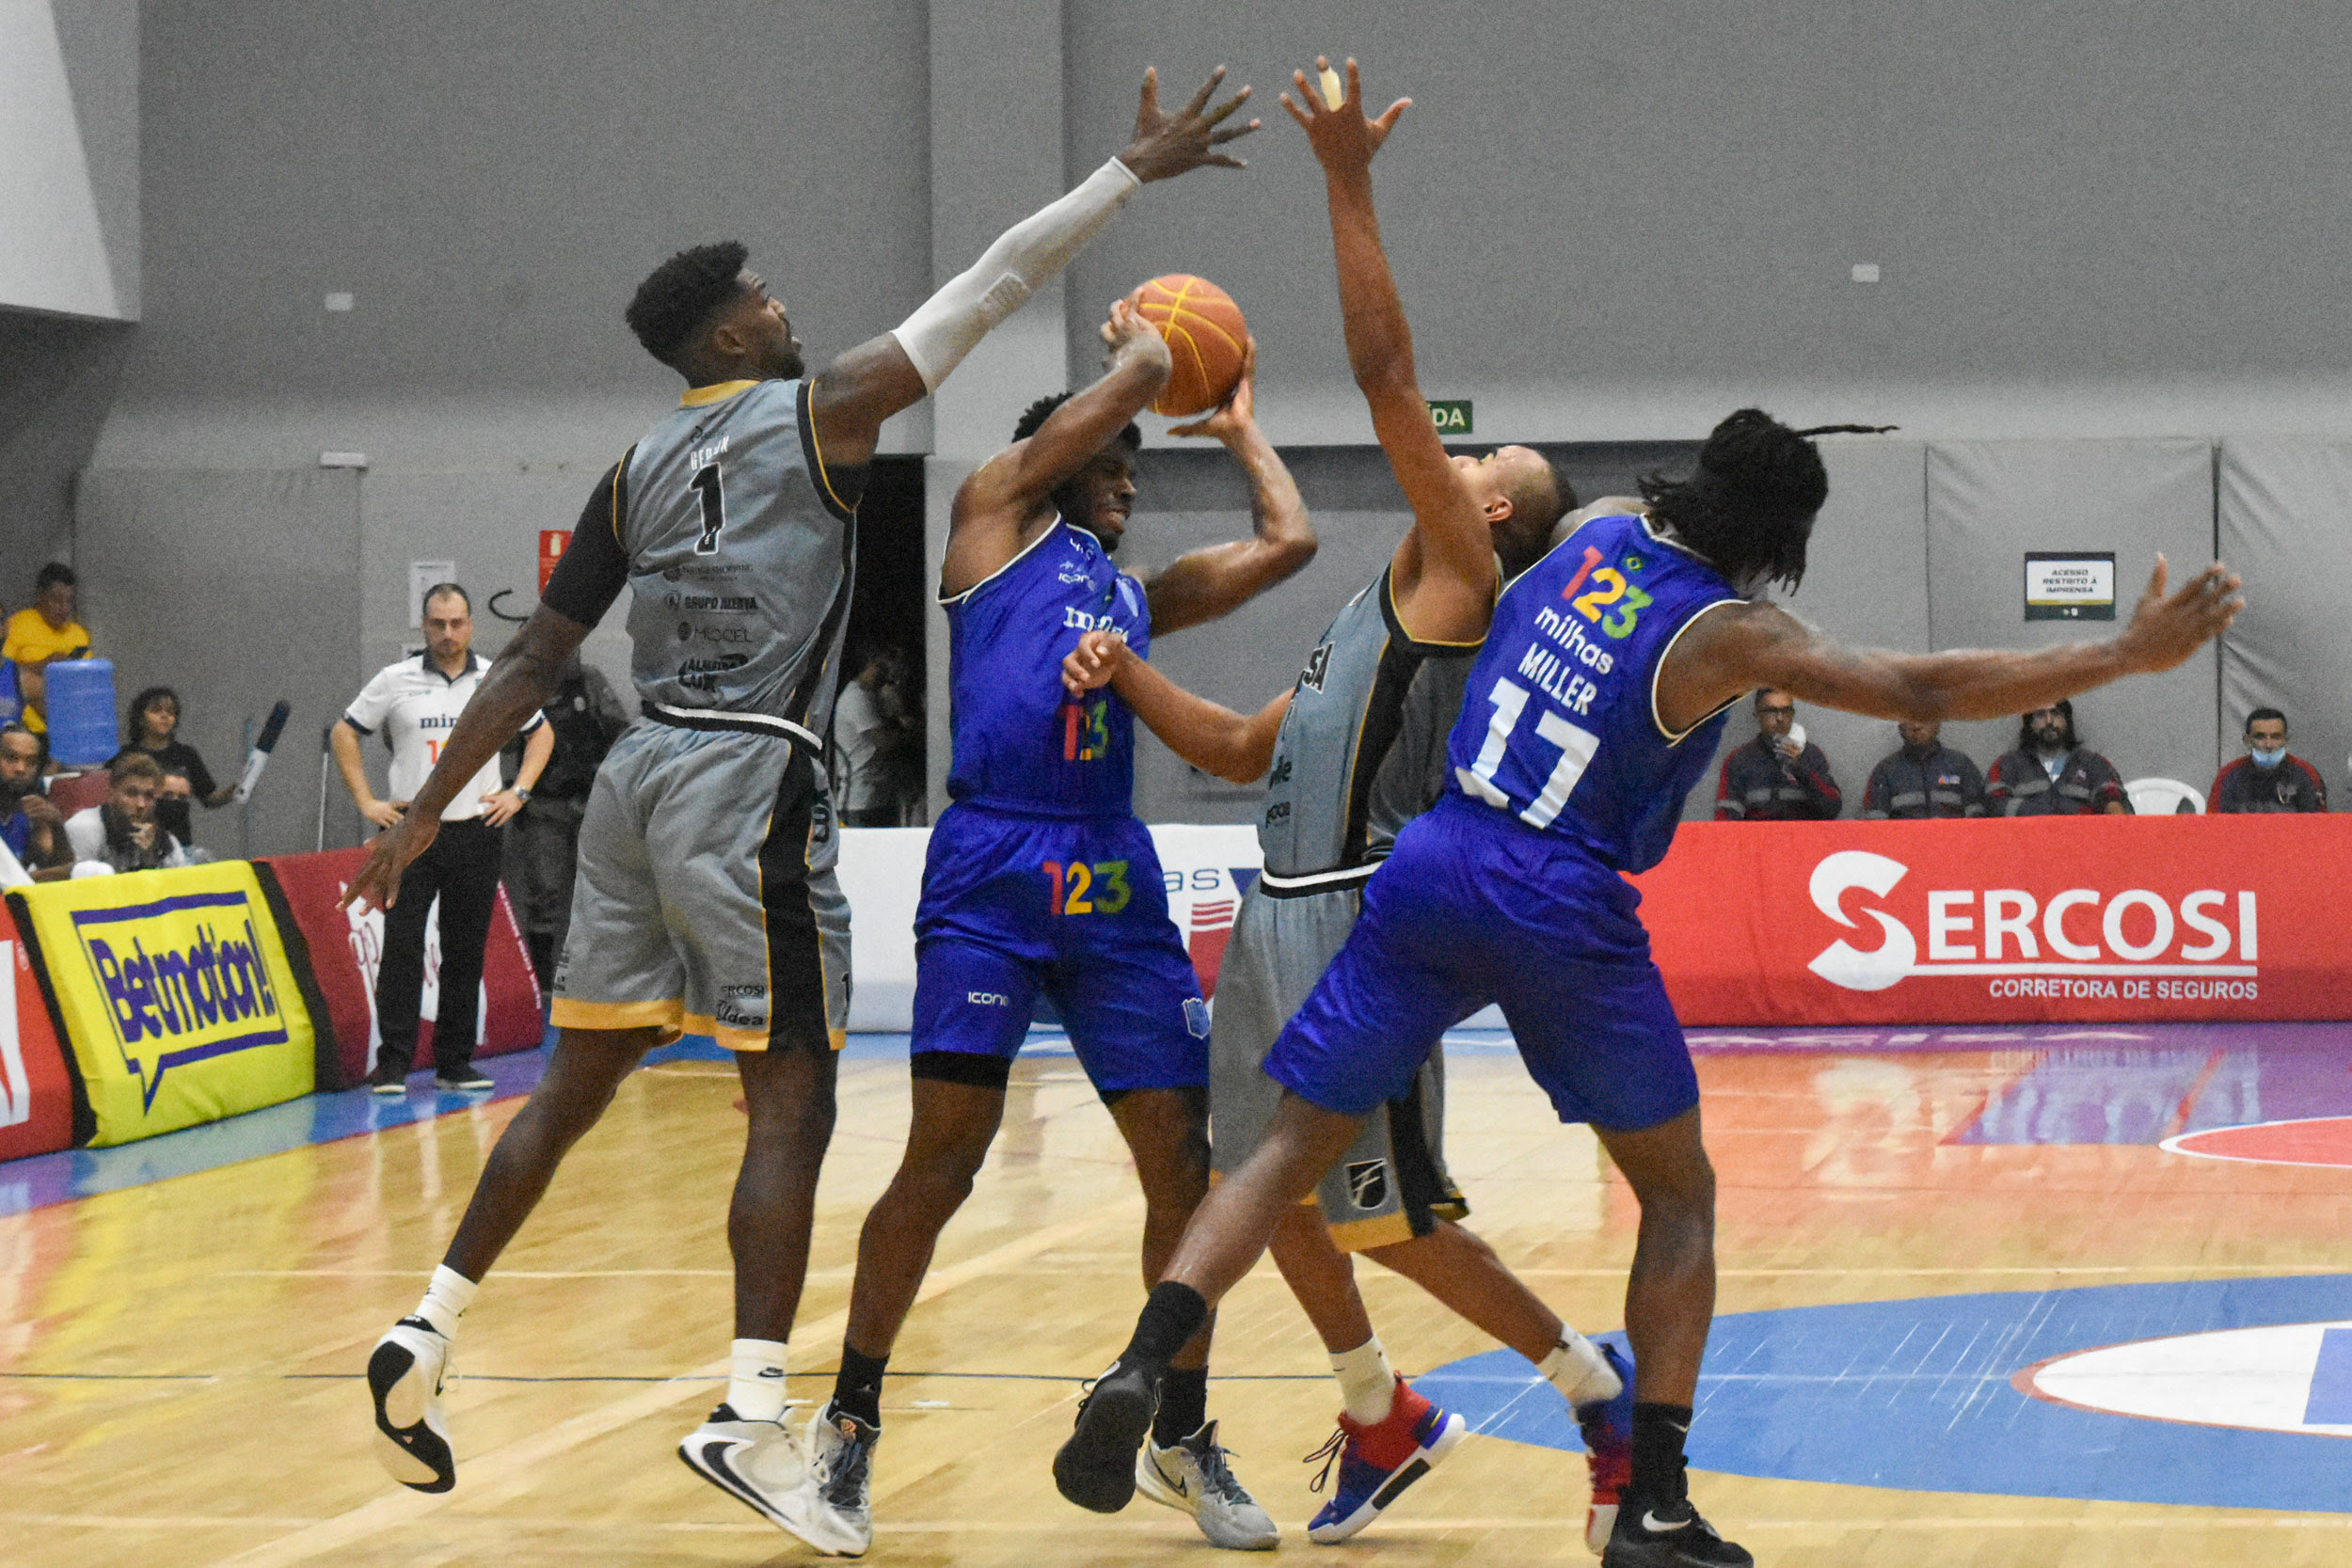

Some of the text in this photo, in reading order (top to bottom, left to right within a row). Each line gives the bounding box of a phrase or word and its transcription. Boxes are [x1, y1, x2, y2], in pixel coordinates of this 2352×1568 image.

[1428, 404, 1465, 427] DA
[689, 461, 725, 556] 1
[684, 596, 718, 610] GRUPO
[1562, 546, 1654, 639] 123
[1534, 606, 1614, 674] milhas
[1518, 641, 1597, 716] MILLER
[1455, 676, 1599, 830] 17
[1042, 860, 1130, 915] 123
[1807, 850, 2258, 991] SERCOSI
[1990, 978, 2258, 1000] CORRETORA DE SEGUROS
